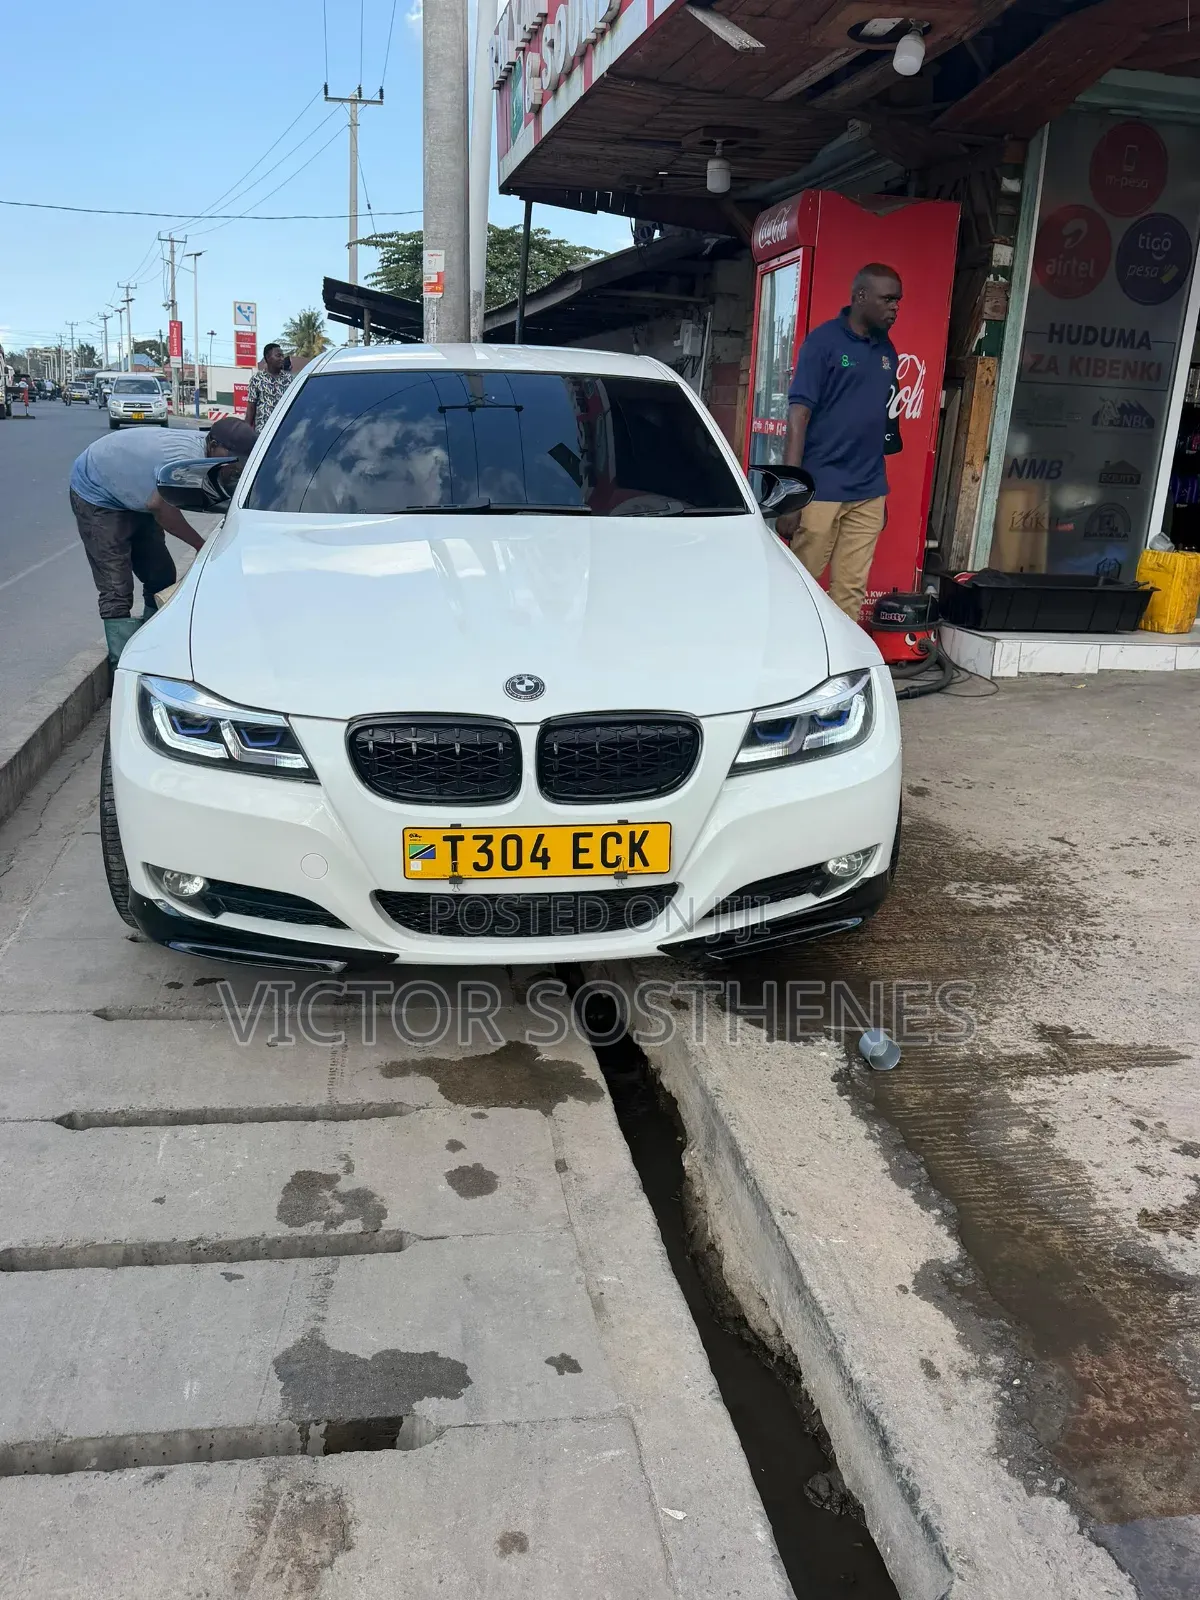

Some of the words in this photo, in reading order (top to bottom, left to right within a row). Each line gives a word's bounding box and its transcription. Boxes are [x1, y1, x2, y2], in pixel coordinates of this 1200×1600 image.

[1105, 174, 1149, 189] m-pesa
[1138, 232, 1173, 260] tigo
[1046, 255, 1095, 278] airtel
[1126, 263, 1159, 280] pesa
[1048, 323, 1152, 350] HUDUMA
[1028, 353, 1060, 376] ZA
[1069, 355, 1163, 383] KIBENKI
[1123, 413, 1149, 427] NBC
[1008, 458, 1063, 480] NMB
[880, 611, 907, 622] Hetty
[442, 833, 551, 872] T304
[572, 830, 650, 870] ECK
